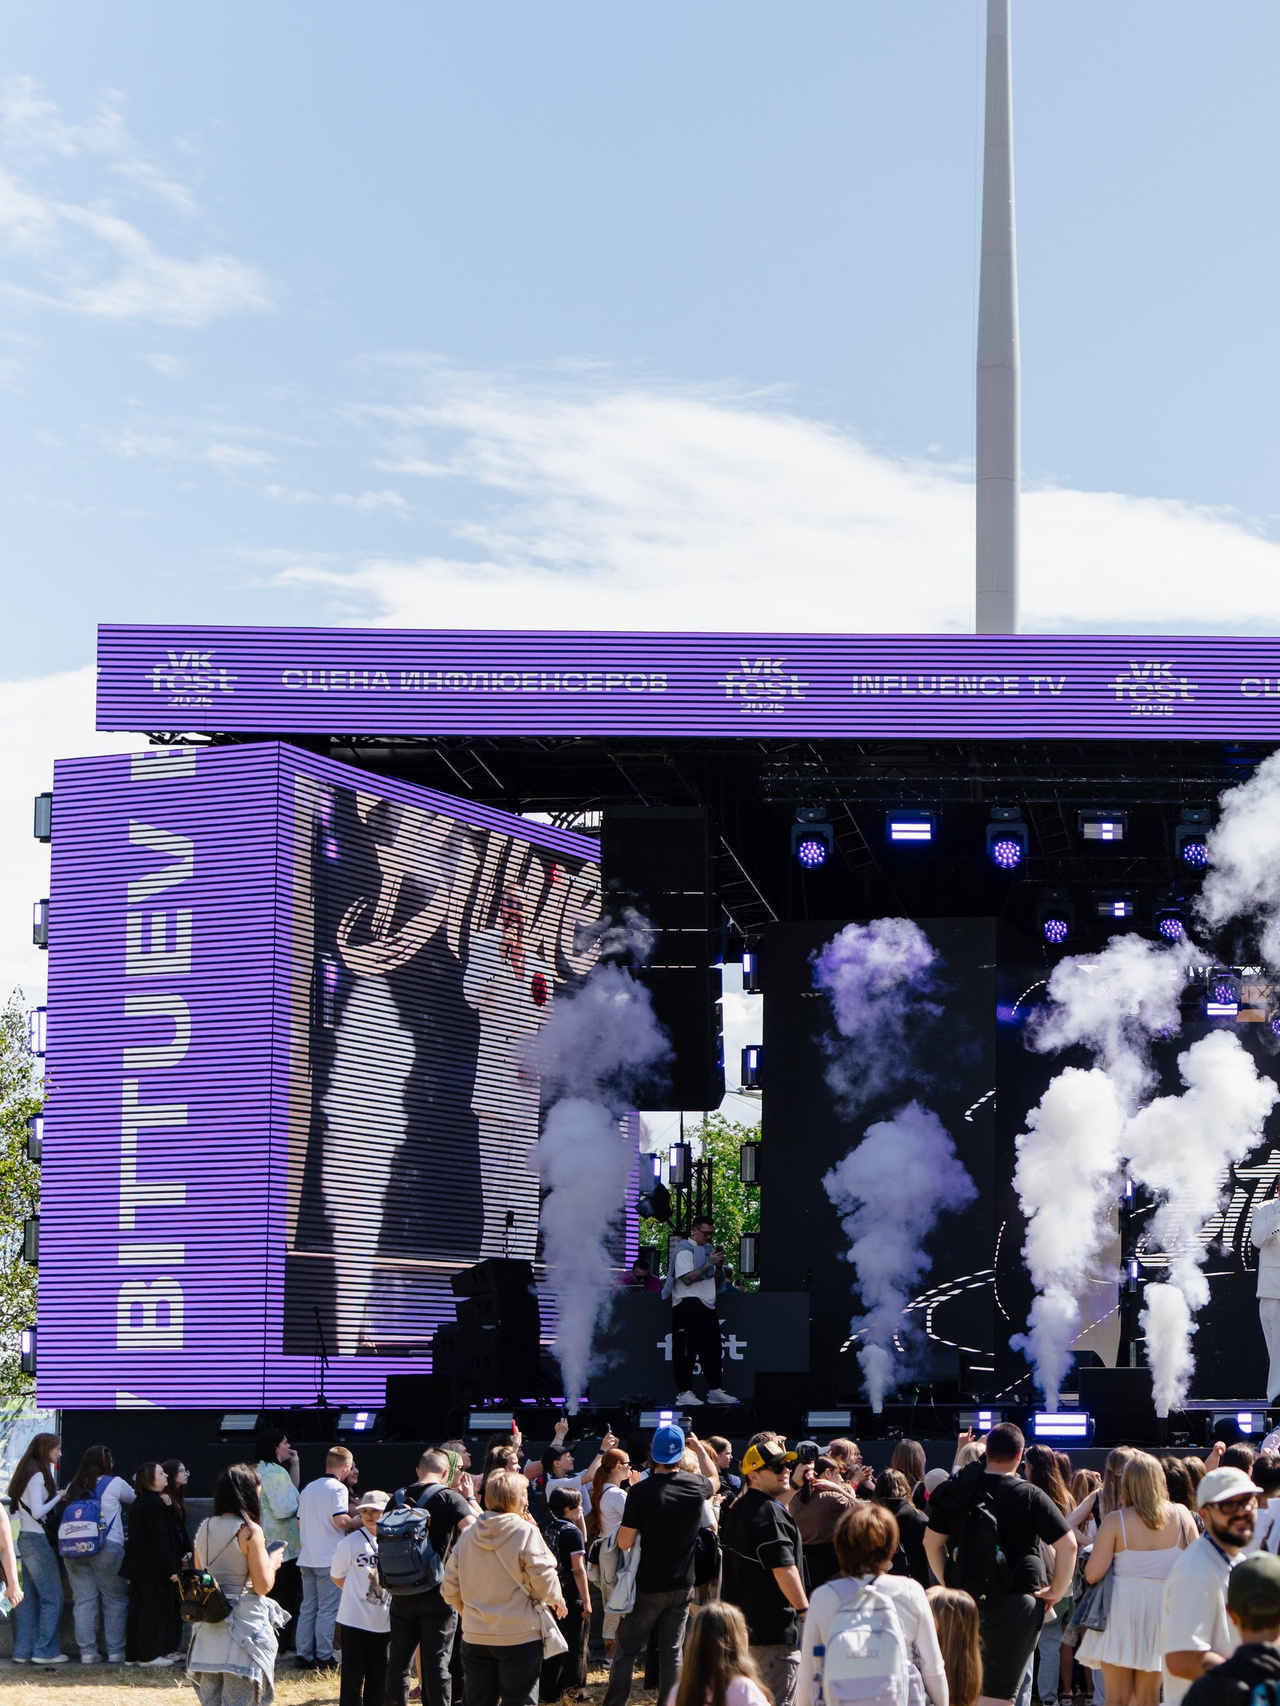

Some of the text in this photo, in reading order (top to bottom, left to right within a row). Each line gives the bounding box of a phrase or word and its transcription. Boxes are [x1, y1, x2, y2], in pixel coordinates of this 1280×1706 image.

[166, 650, 216, 671] VK
[739, 657, 788, 677] VK
[1129, 660, 1176, 680] VK
[145, 664, 238, 693] fest
[281, 669, 669, 692] СЦЕНА ИНФЛЮЕНСЕРОВ
[718, 671, 809, 699] fest
[852, 676, 1066, 696] INFLUENCE TV
[1107, 674, 1199, 702] fest
[116, 818, 195, 1351] BITTUEV
[656, 1332, 748, 1361] ft
